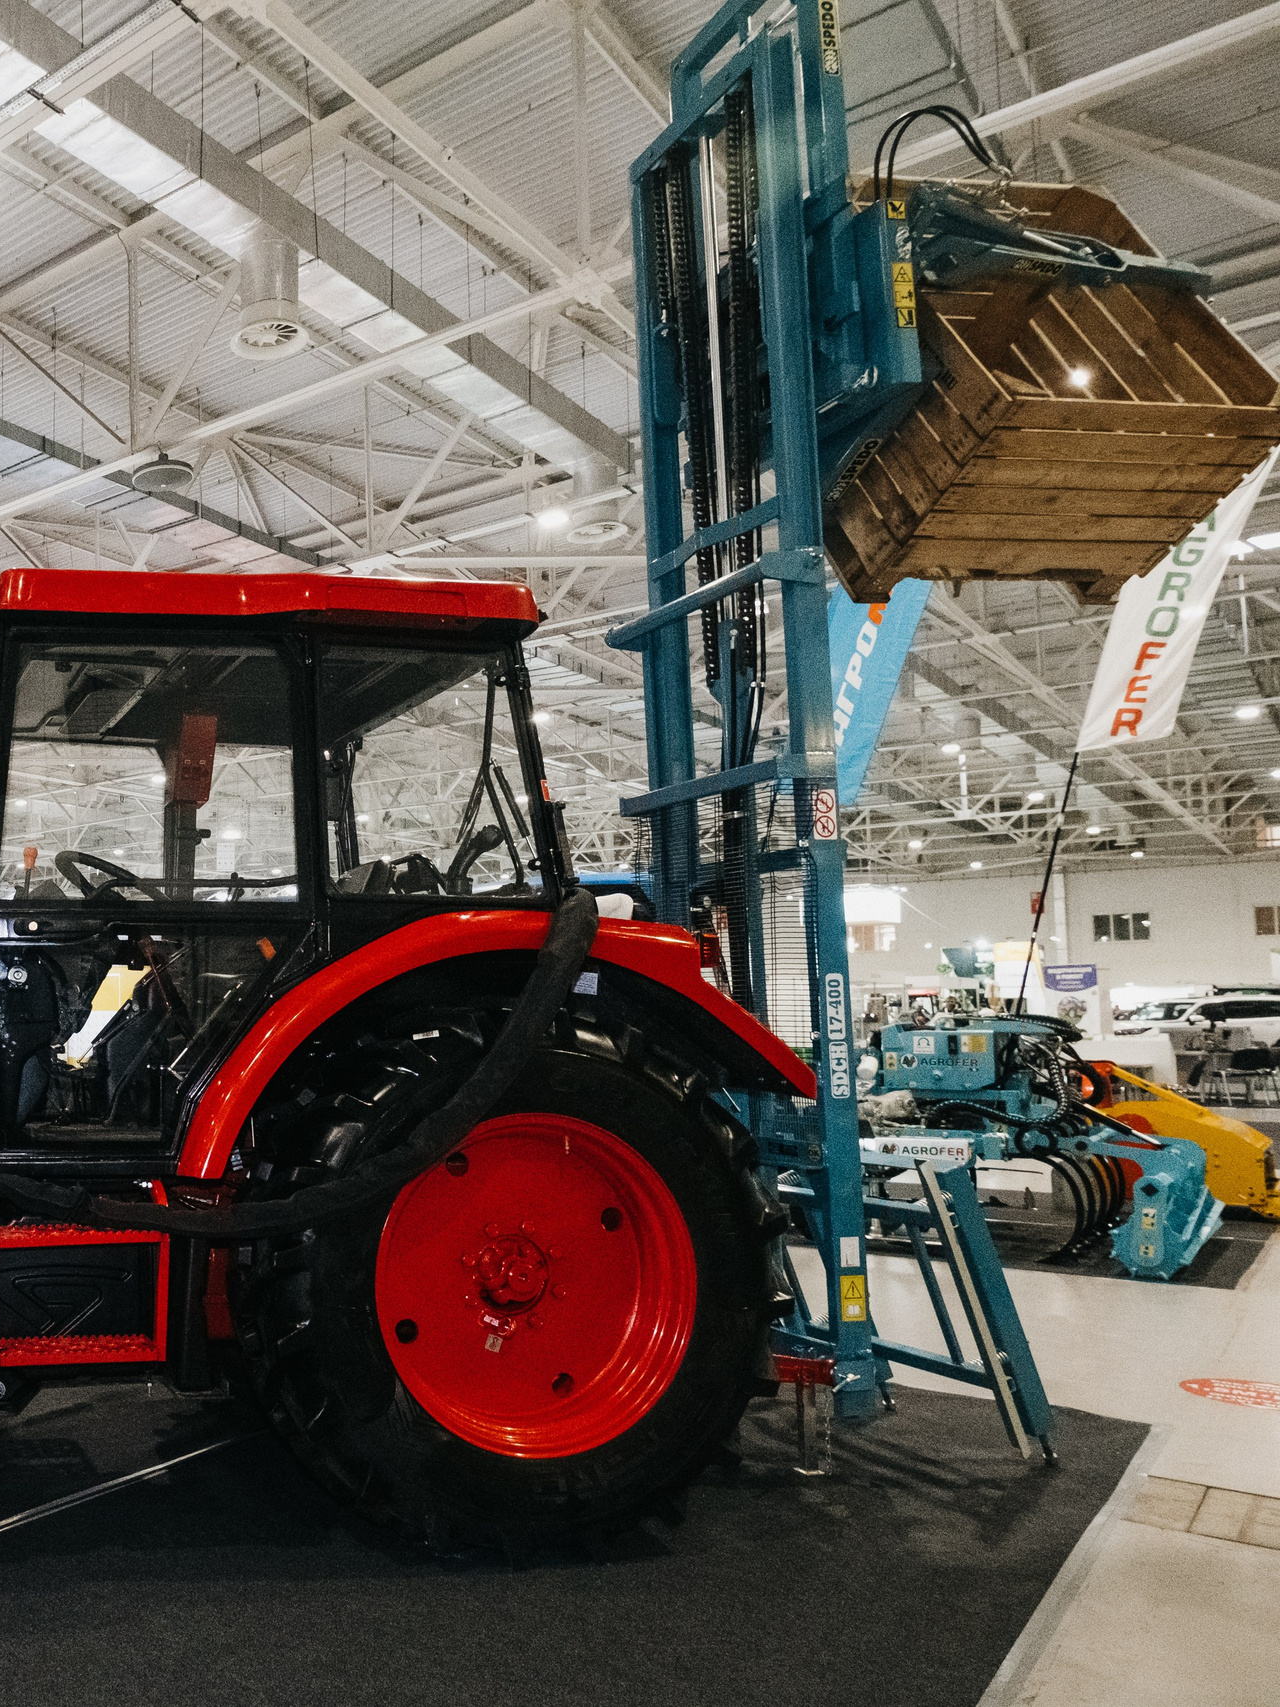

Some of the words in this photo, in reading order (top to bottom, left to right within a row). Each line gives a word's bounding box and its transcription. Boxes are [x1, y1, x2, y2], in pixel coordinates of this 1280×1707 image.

[821, 1, 836, 47] SPEDO
[1029, 260, 1063, 275] SPEDO
[840, 440, 879, 480] SPEDO
[827, 978, 843, 1035] 17-400
[829, 1042, 849, 1097] SDCH
[920, 1057, 979, 1067] AGROFER
[902, 1146, 964, 1156] AGROFER
